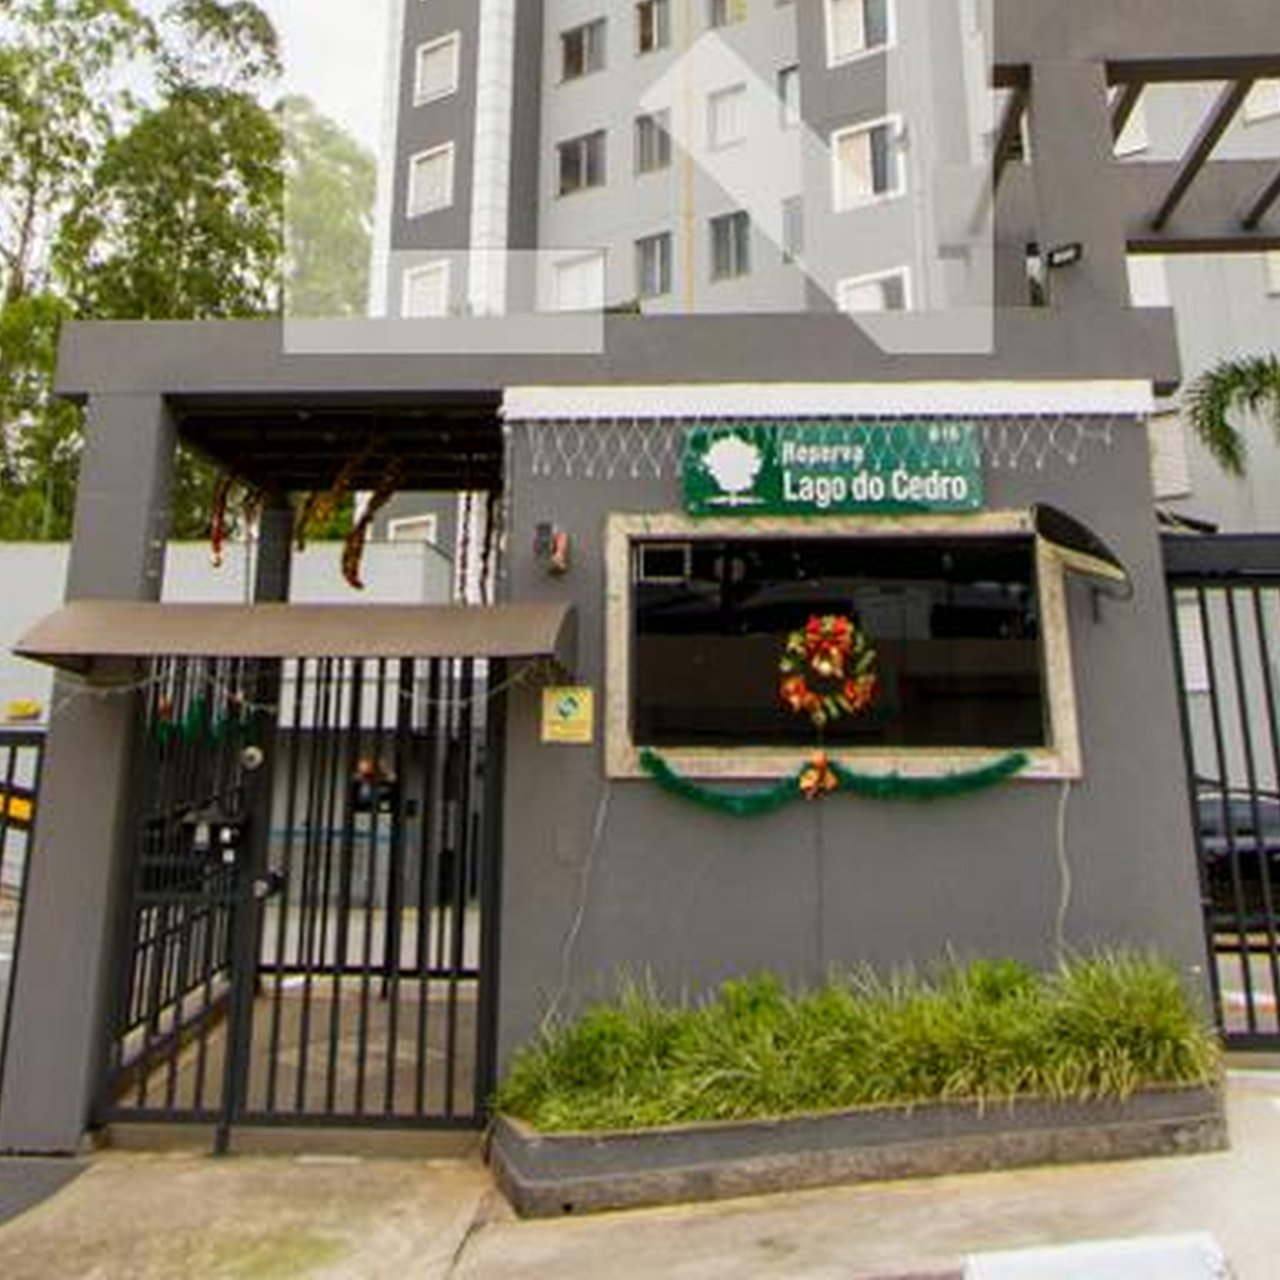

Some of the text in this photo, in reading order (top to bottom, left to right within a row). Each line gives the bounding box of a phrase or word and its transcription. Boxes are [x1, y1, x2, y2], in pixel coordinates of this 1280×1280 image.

[783, 469, 968, 508] Lago do Cedro
